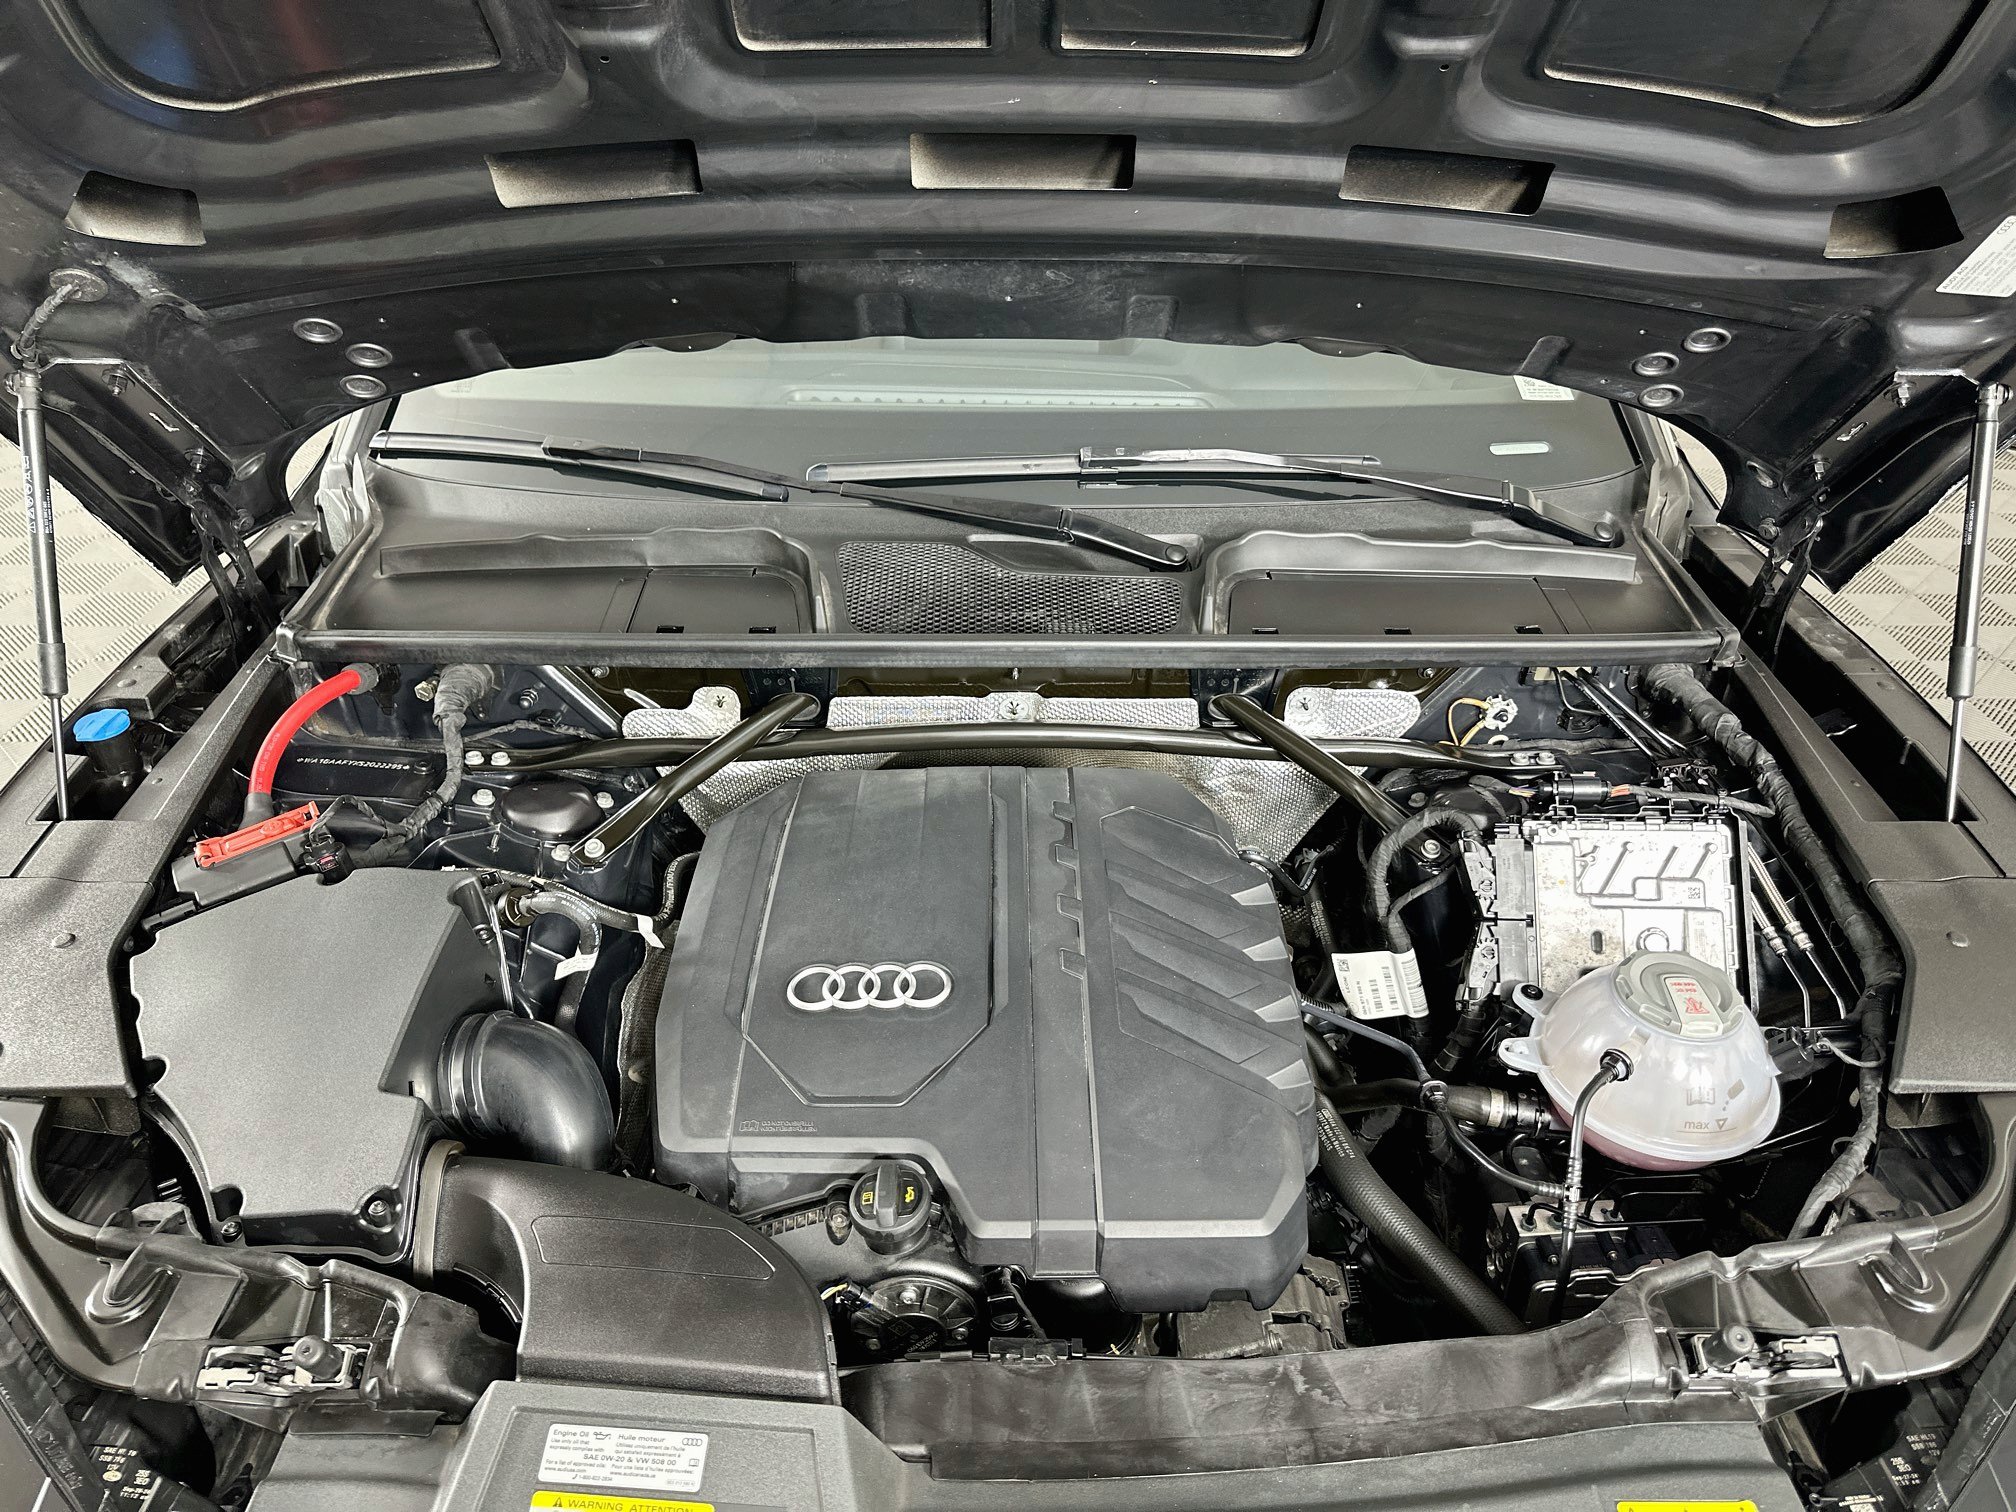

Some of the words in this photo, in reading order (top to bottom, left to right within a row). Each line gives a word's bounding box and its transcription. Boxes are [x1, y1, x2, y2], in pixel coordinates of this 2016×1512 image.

[1943, 275, 1958, 289] AUDI
[1957, 266, 1968, 276] AG
[1684, 1121, 1710, 1130] max
[553, 1429, 577, 1437] Engine
[103, 1446, 118, 1454] SAE
[568, 1499, 623, 1512] WARNING
